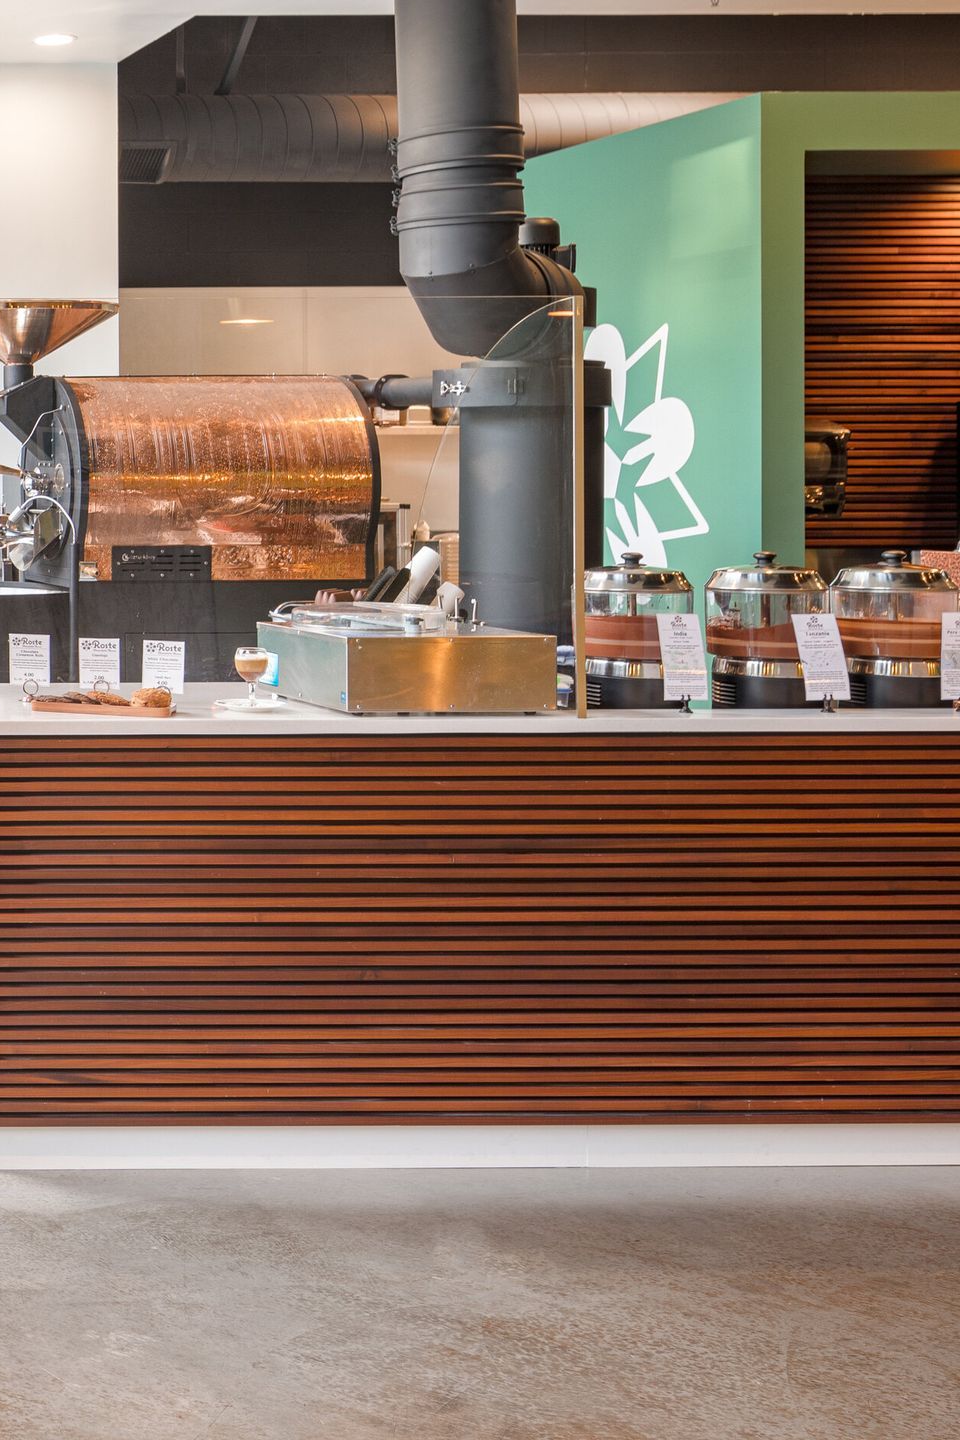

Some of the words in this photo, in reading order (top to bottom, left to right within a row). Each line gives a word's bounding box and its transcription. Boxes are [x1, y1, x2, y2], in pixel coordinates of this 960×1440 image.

[21, 637, 42, 646] Roste
[91, 640, 117, 649] Roste
[156, 642, 182, 652] Roste
